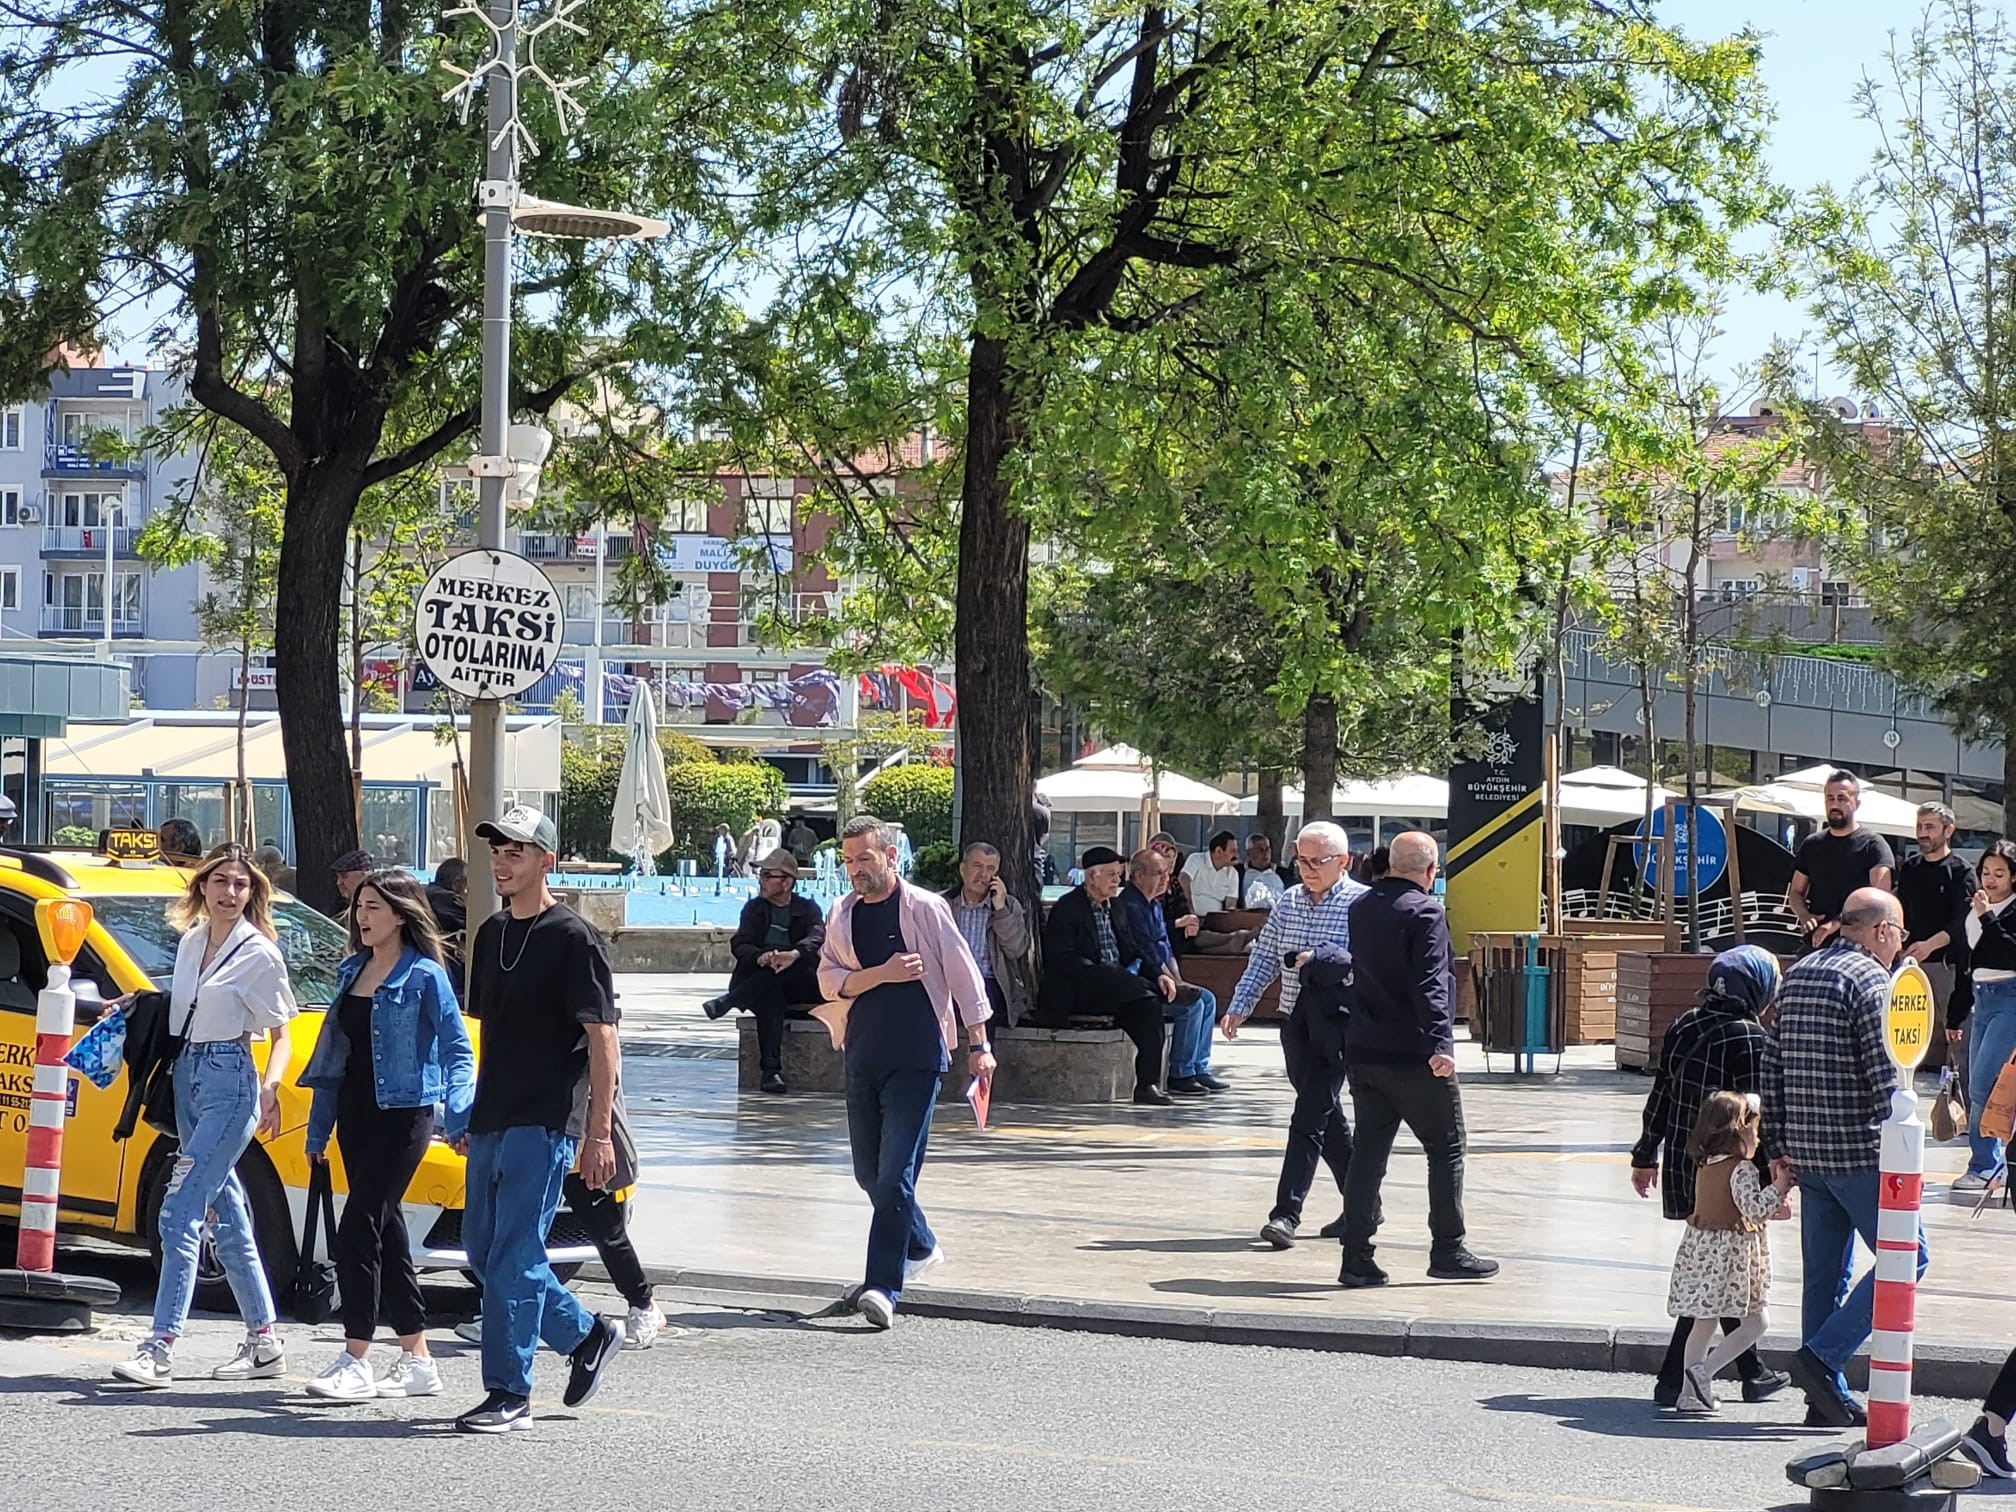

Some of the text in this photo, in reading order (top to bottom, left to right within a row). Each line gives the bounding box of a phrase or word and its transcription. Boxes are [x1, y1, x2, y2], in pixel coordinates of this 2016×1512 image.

[435, 577, 550, 608] MERKEZ
[415, 669, 437, 686] Ay
[1467, 783, 1527, 793] BÜYÜKŞEHİR
[1891, 995, 1927, 1012] MERKEZ
[1894, 1023, 1921, 1044] TAKSİ
[0, 1042, 35, 1068] ERK
[0, 1072, 34, 1094] AKS
